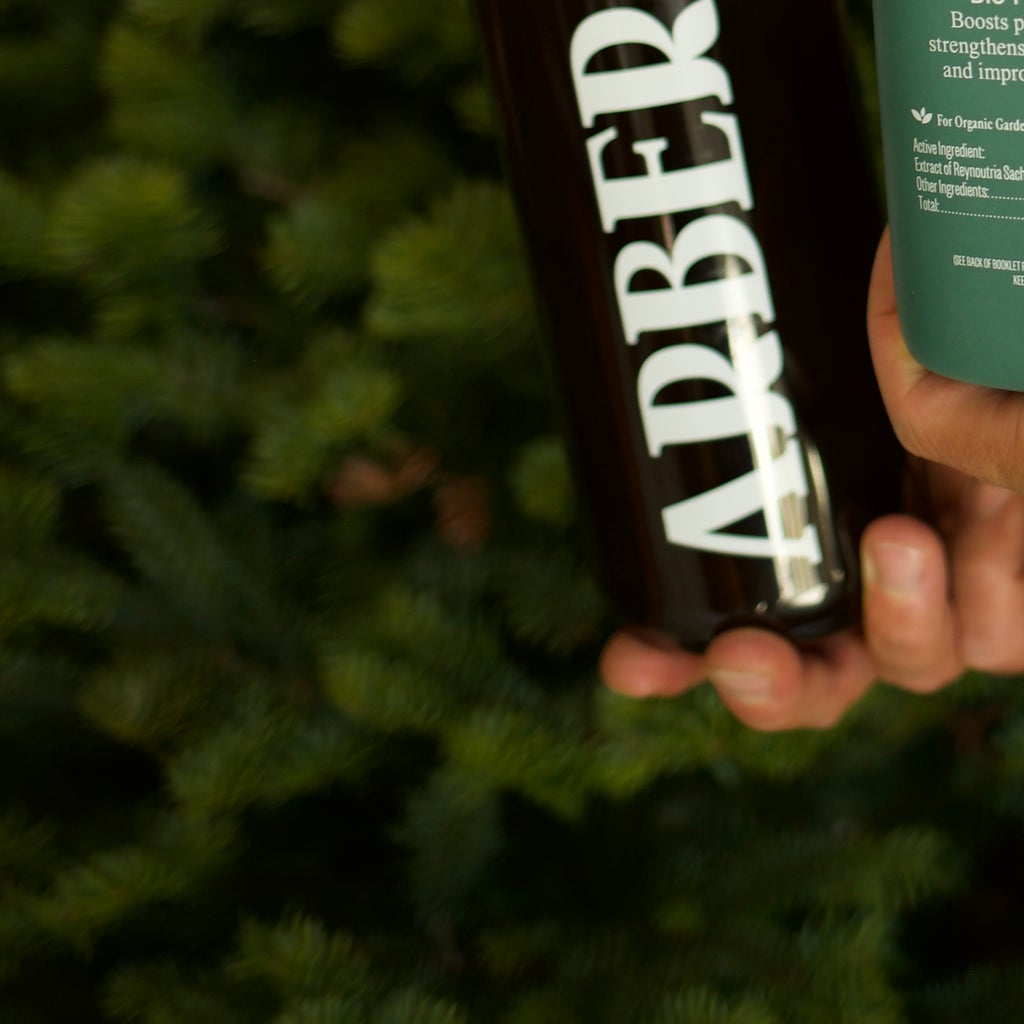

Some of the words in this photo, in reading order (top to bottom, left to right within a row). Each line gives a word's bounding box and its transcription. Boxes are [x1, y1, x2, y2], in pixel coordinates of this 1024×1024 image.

[950, 11, 1009, 31] Boosts
[943, 62, 973, 80] and
[936, 114, 953, 127] For
[955, 115, 993, 132] Organic
[913, 138, 938, 156] Active
[938, 141, 985, 160] Ingredient:
[914, 157, 943, 175] Extract
[943, 161, 953, 176] of
[953, 161, 1002, 181] Reynoutria
[916, 176, 937, 193] Other
[953, 254, 967, 266] (SEE
[966, 256, 983, 269] BACK
[983, 258, 992, 269] OF
[992, 258, 1021, 272] BOOKLET
